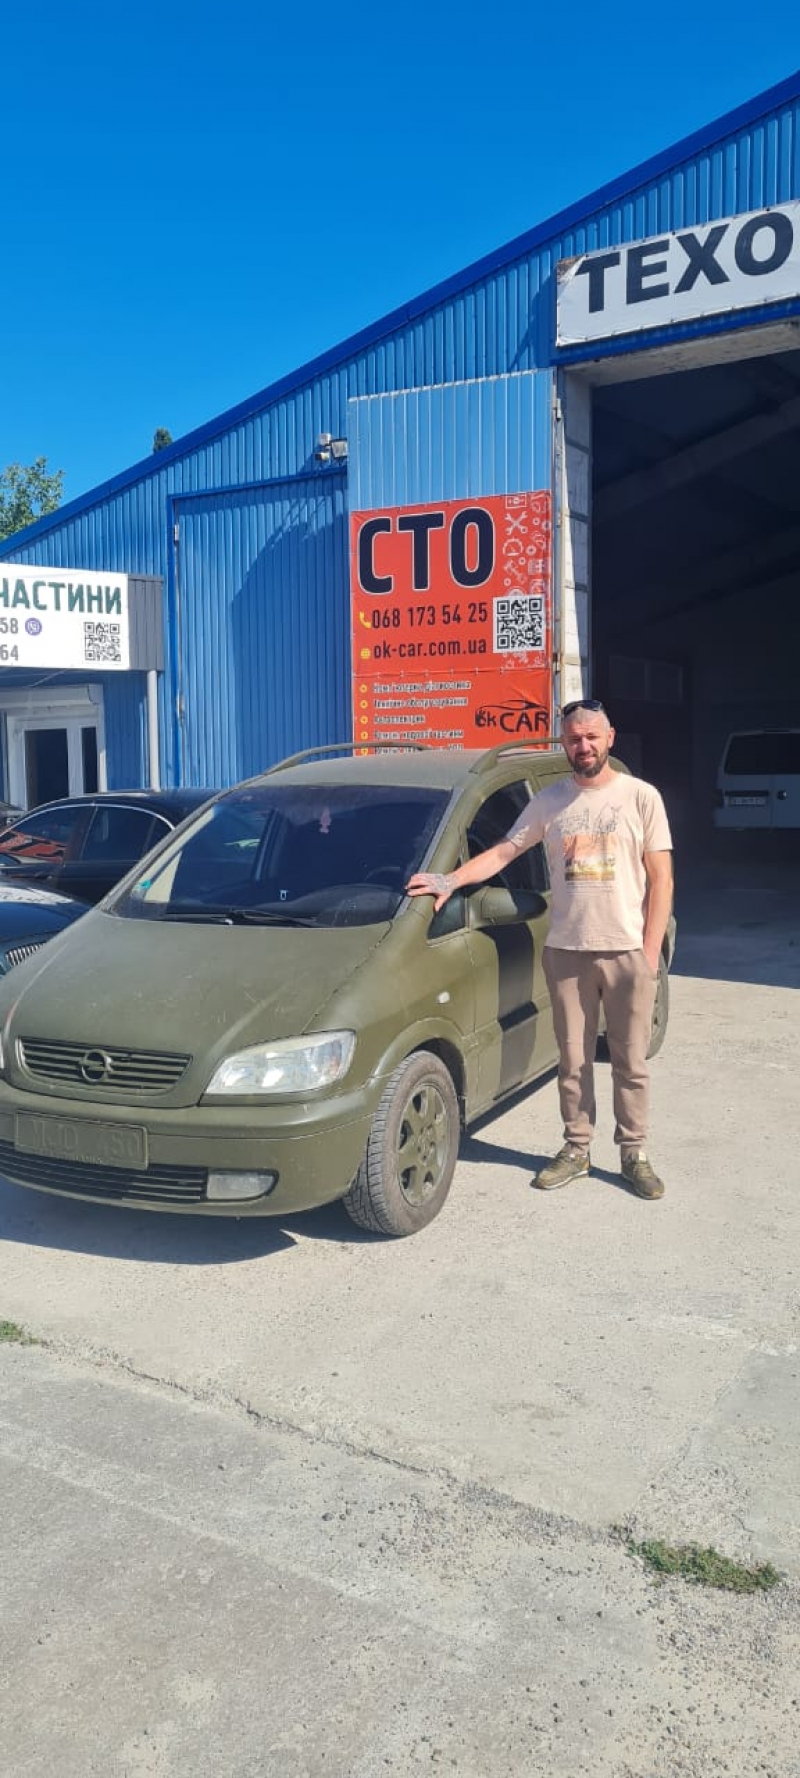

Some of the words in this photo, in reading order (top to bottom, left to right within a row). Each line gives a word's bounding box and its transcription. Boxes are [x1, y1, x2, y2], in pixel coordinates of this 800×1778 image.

[575, 212, 794, 314] ТЕХО
[357, 506, 496, 595] СТО
[372, 608, 401, 629] 068
[408, 605, 436, 627] 173
[442, 603, 462, 625] 54
[467, 602, 488, 622] 25
[374, 639, 487, 659] ok-car.com.ua
[499, 711, 549, 733] CAR
